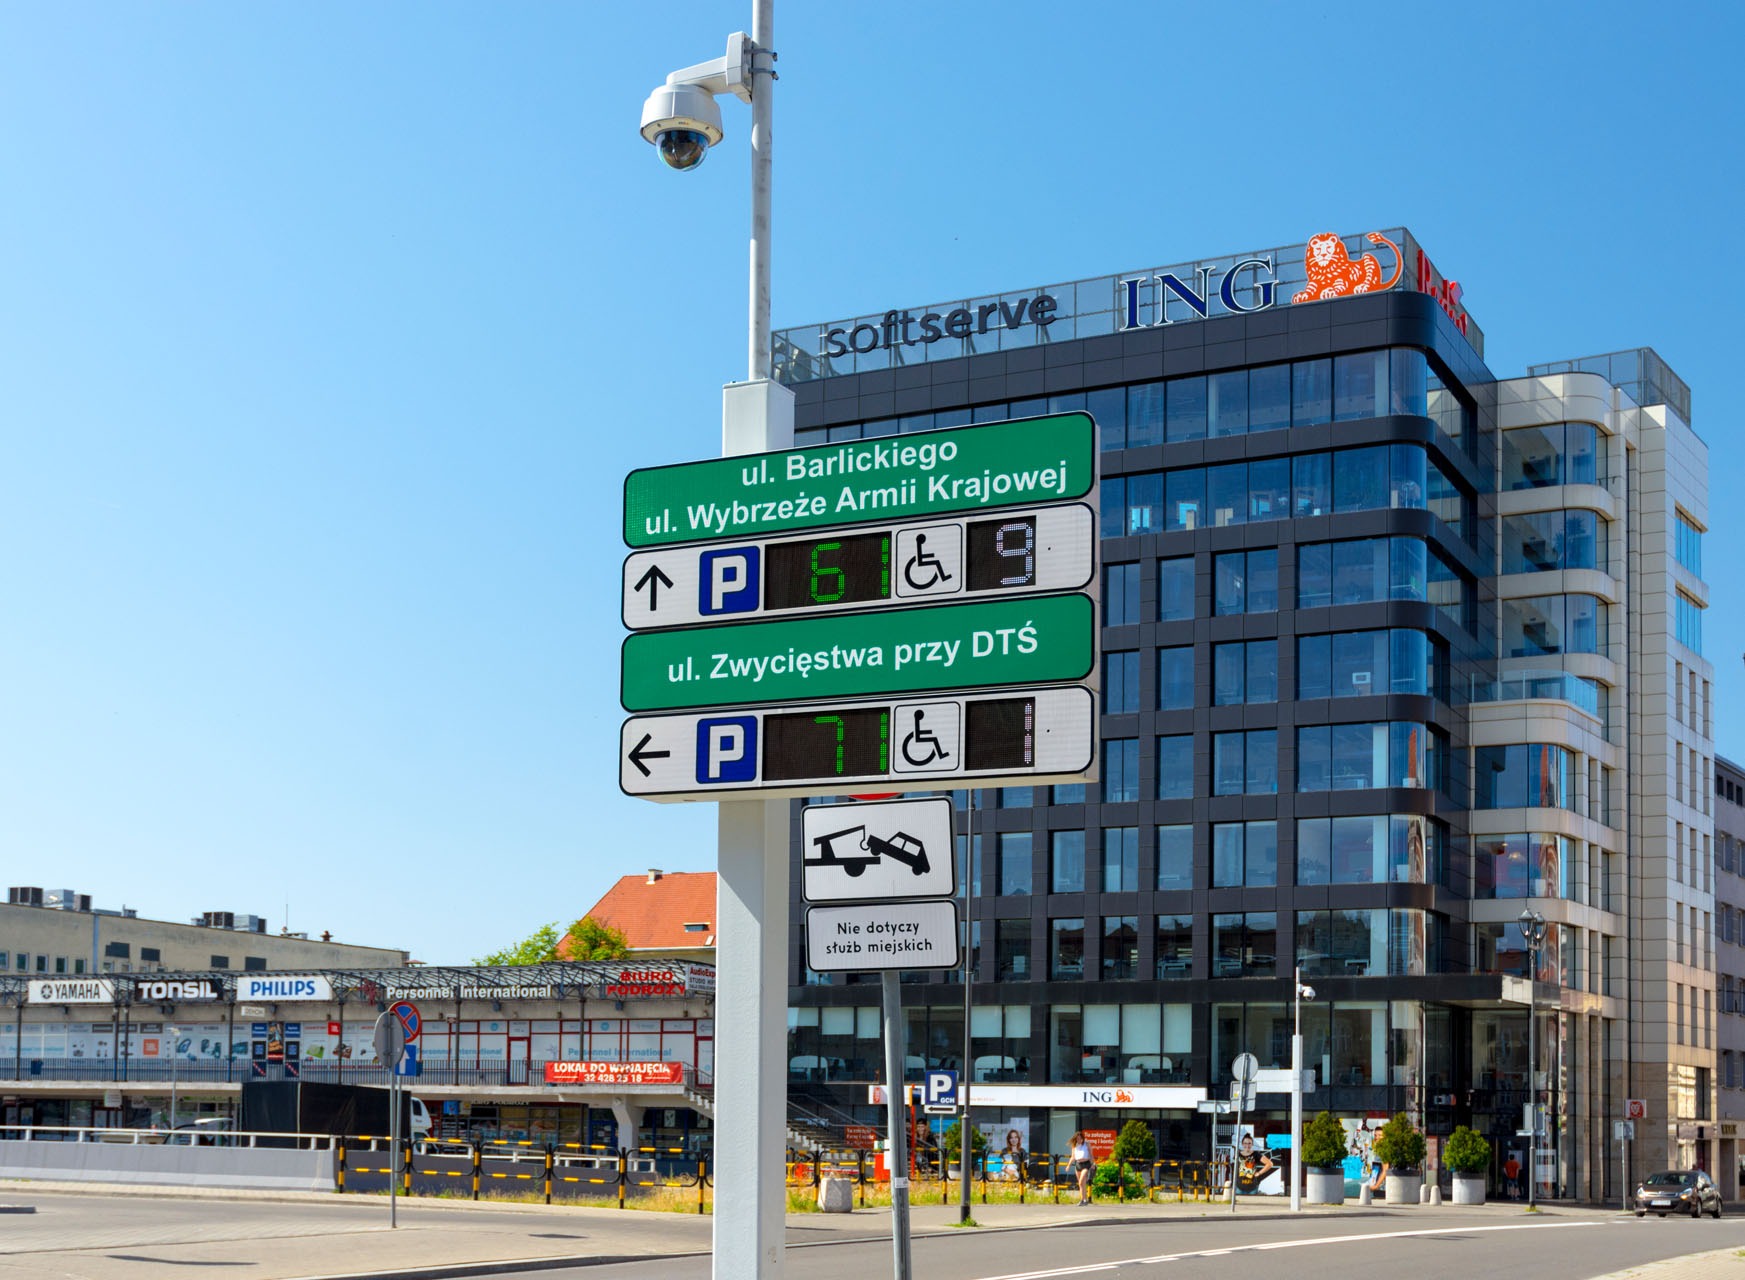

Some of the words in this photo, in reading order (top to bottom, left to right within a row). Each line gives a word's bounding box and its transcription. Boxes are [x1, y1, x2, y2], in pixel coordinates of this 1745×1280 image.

[1119, 255, 1279, 331] ING
[826, 294, 1058, 358] softserve
[742, 459, 775, 486] ul.
[786, 440, 958, 481] Barlickiego
[645, 508, 678, 535] ul.
[687, 492, 827, 534] Wybrzeże
[835, 478, 917, 513] Armii
[928, 460, 1067, 503] Krajowej
[996, 521, 1034, 586] 9
[668, 656, 701, 682] ul.
[709, 642, 884, 683] Zwycięstwa
[894, 639, 961, 670] przy
[971, 620, 1039, 658] DTŚ
[1024, 702, 1034, 765] 1
[837, 922, 861, 935] Nie
[866, 920, 920, 937] dotyczy
[826, 940, 862, 955] służb
[867, 938, 933, 955] miejskich
[619, 970, 674, 982] BIURO
[53, 982, 101, 999] YAMAHA
[250, 980, 316, 996] PHILIPS
[386, 985, 454, 999] Personnel
[459, 984, 551, 998] International
[553, 1063, 588, 1073] LOKAL
[589, 1063, 607, 1073] DO
[608, 1063, 671, 1076] WYNAJĘCIA
[584, 1073, 595, 1083] 32
[597, 1073, 615, 1083] 428
[617, 1073, 629, 1083] 25
[631, 1073, 642, 1083] 18
[929, 1074, 953, 1101] P
[1082, 1091, 1112, 1103] ING
